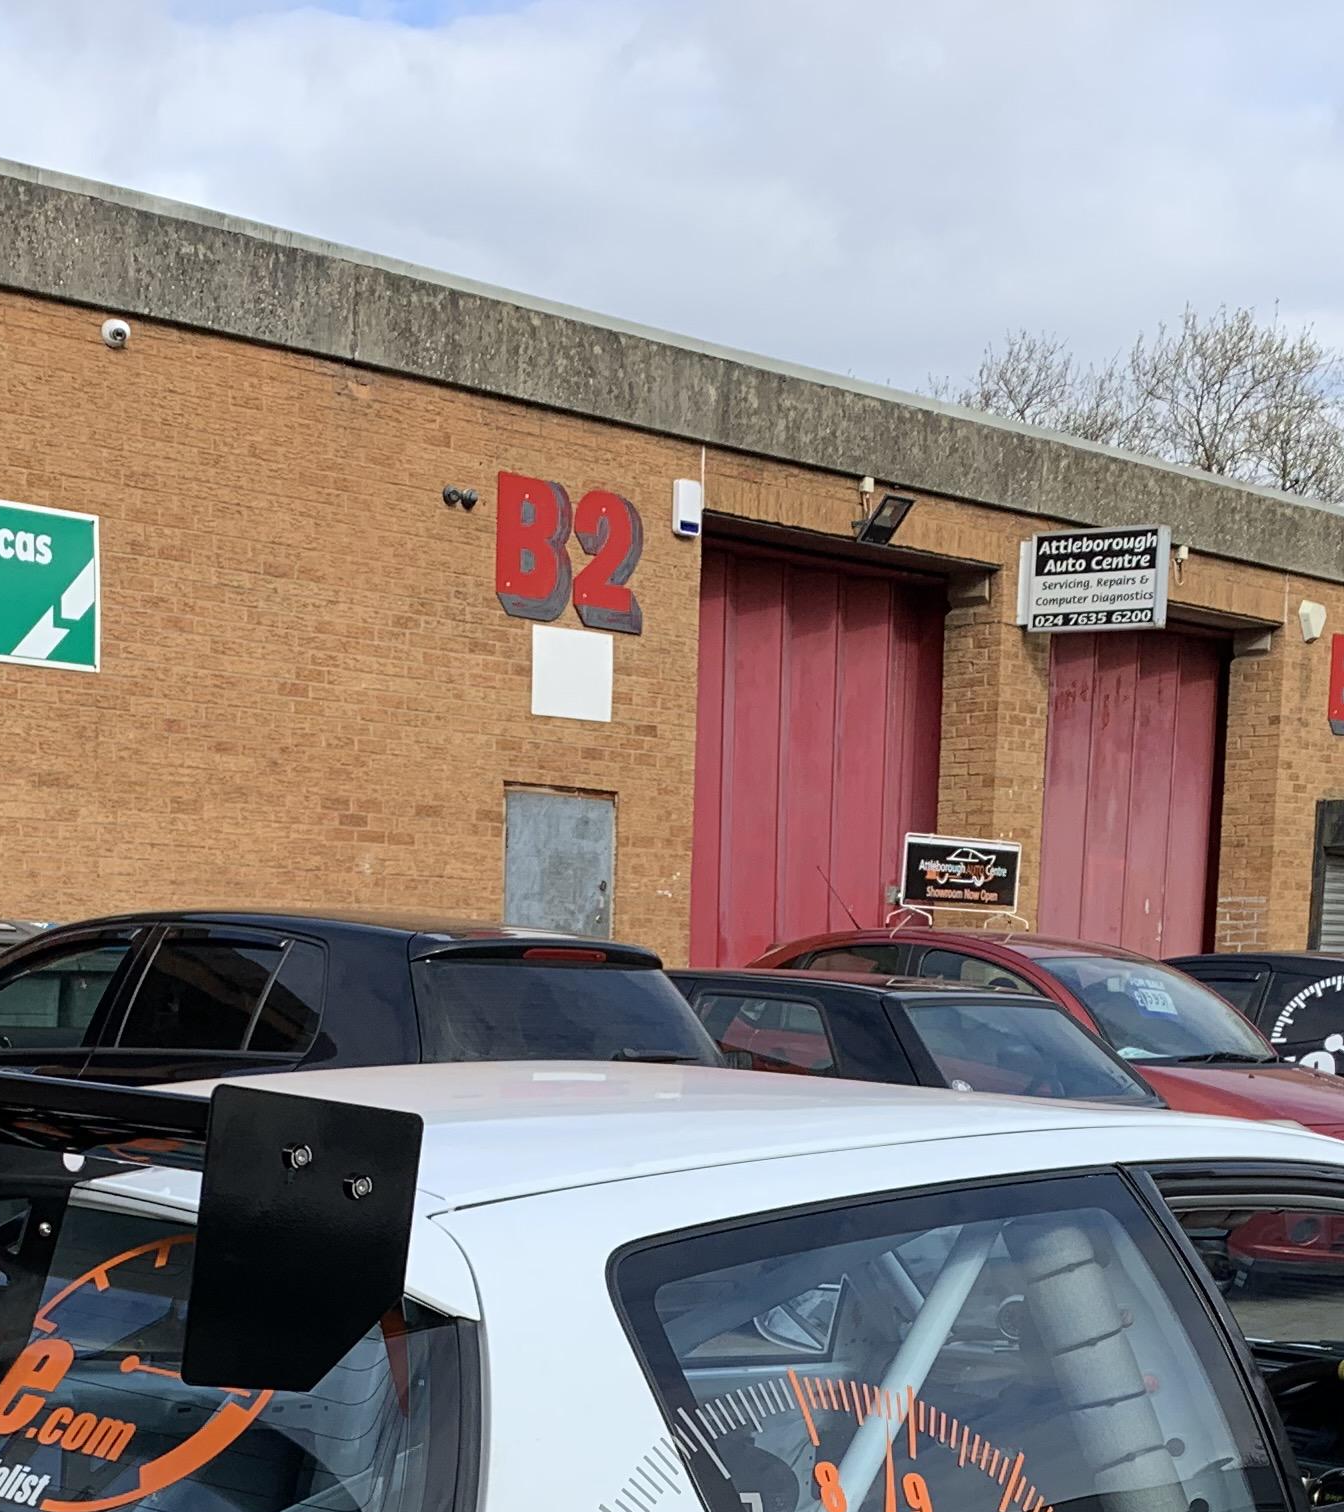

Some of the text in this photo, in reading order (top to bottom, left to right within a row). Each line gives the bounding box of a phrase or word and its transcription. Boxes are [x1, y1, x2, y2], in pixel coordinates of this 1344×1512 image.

[496, 471, 643, 634] B2
[1038, 532, 1156, 556] Attleborough
[1044, 554, 1150, 573] Auto Centre
[1096, 576, 1136, 588] Repairs
[1140, 575, 1149, 584] &
[1035, 590, 1154, 608] Computer Diagnostics
[1035, 609, 1151, 627] 024 7635 6200
[918, 859, 966, 876] Attleborough
[986, 865, 1007, 877] Centre
[926, 886, 998, 903] Showroom Now Open
